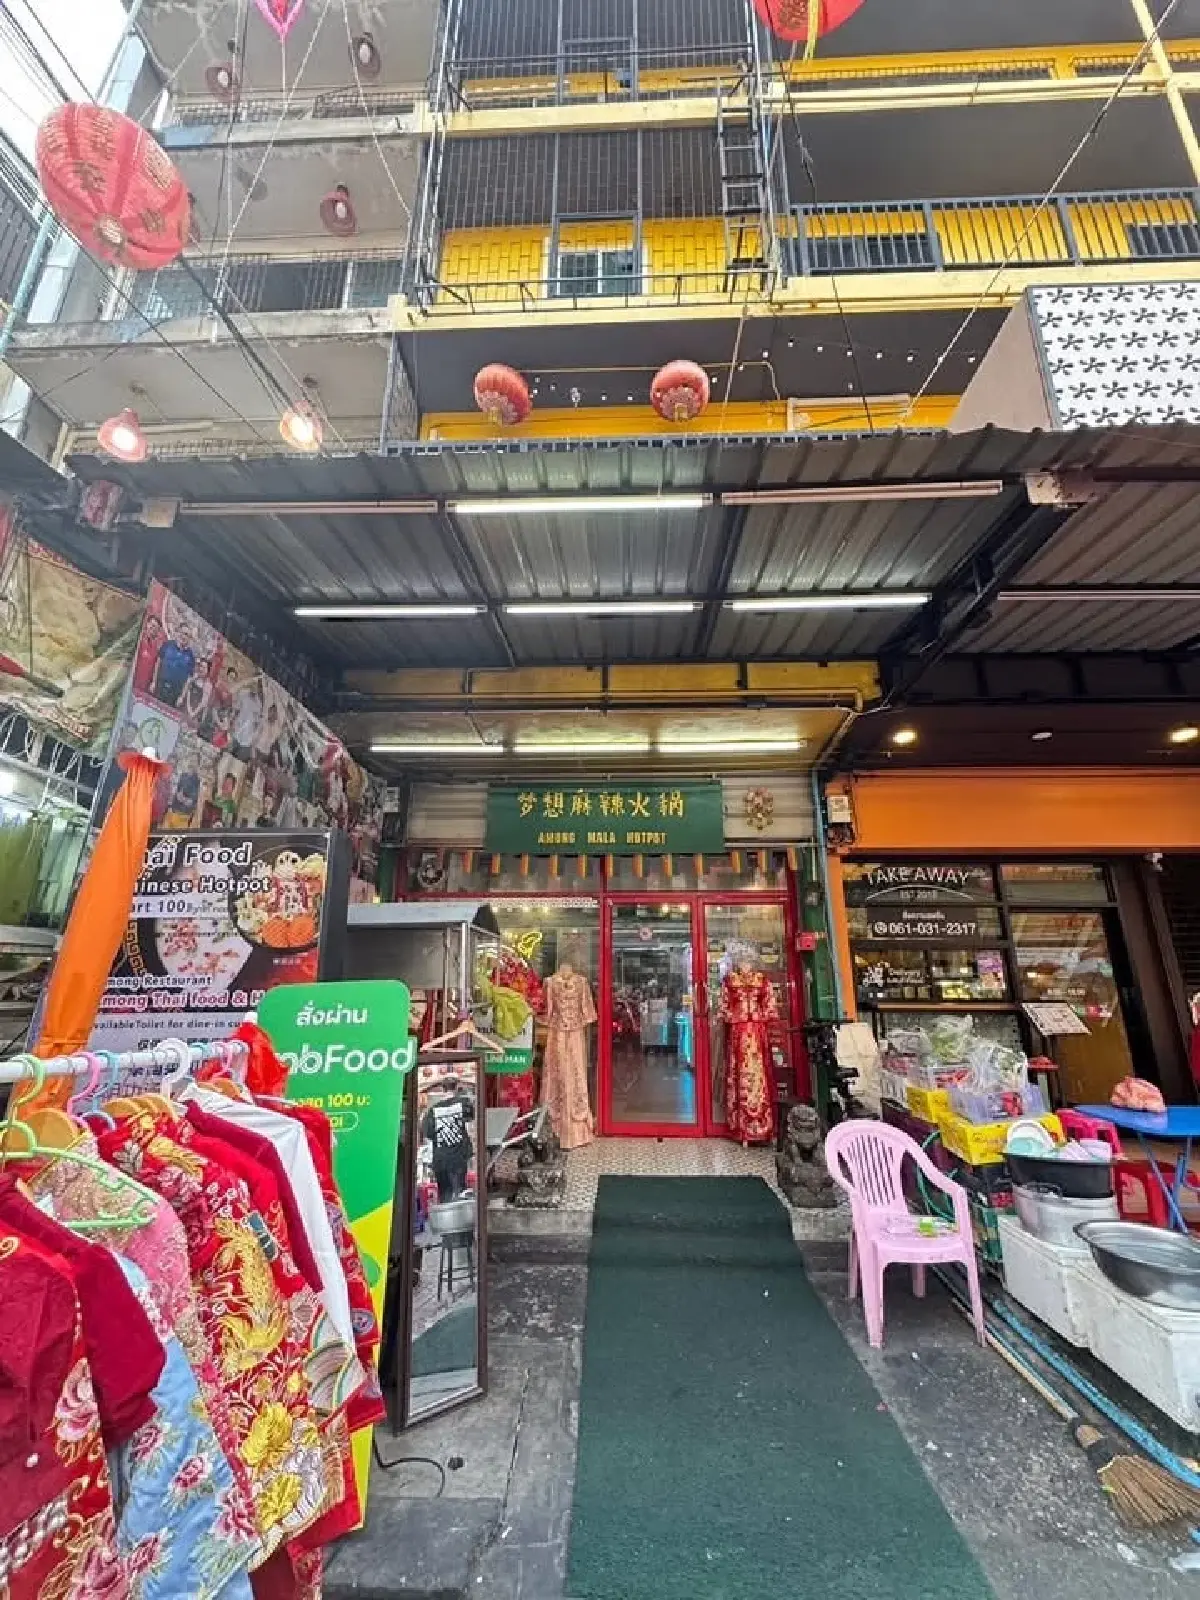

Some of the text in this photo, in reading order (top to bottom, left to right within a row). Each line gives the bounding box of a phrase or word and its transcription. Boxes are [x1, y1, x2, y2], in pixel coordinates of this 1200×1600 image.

[518, 788, 684, 818] 梦想麻辣火锅
[538, 831, 667, 844] AMONG MALA HOTPOT
[143, 842, 253, 868] ai Food
[864, 866, 968, 885] TAKE AWAY
[135, 876, 271, 896] inese Hotpot
[159, 899, 186, 913] 100
[889, 922, 976, 936] 061-031-2317
[107, 975, 211, 989] mong Restaurant
[101, 993, 147, 1011] mong
[152, 990, 188, 1007] Thai
[191, 989, 229, 1007] food
[232, 991, 248, 1007] &
[296, 1001, 368, 1026] สั่งผ่าน
[168, 1020, 184, 1028] for
[275, 1037, 417, 1074] abFood
[328, 1093, 354, 1108] 100
